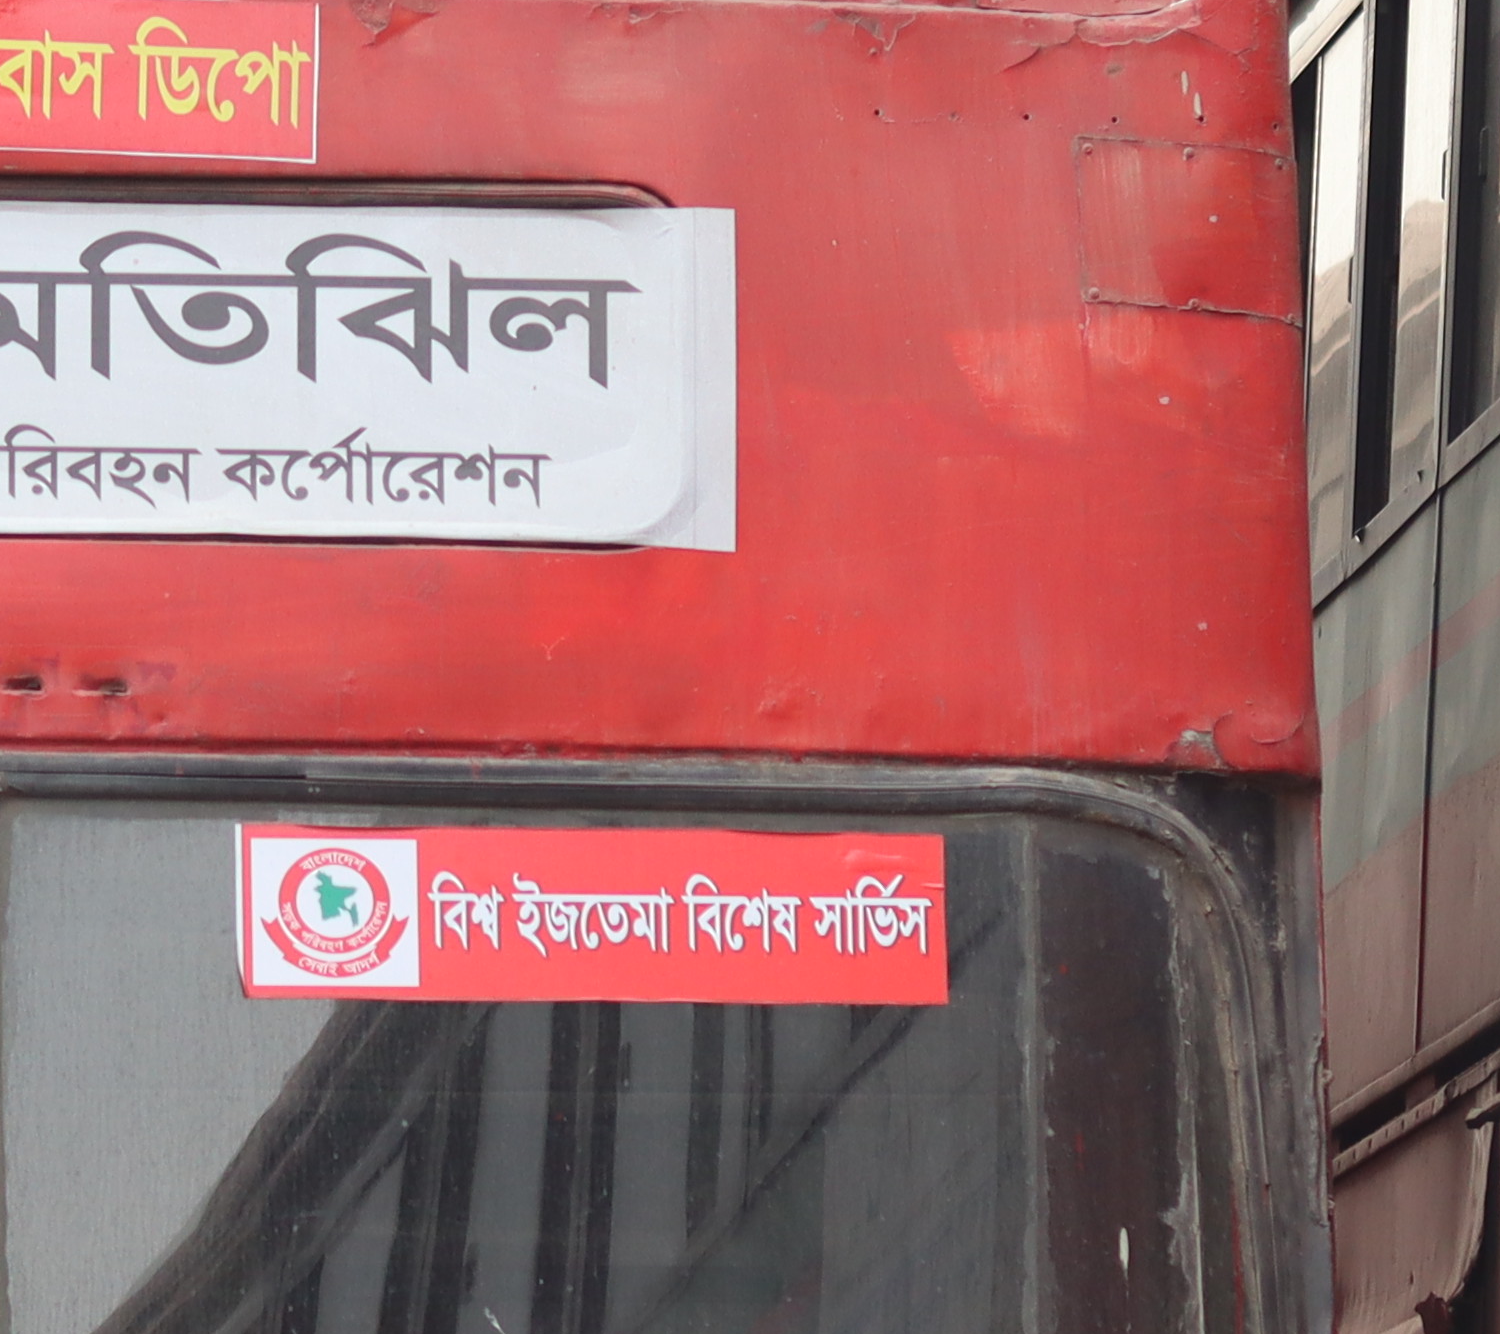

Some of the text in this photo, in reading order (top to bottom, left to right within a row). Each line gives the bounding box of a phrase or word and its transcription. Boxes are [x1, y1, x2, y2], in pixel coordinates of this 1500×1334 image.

[129, 16, 312, 130] ডিপো
[215, 427, 553, 509] কর্পোরেশন
[301, 851, 367, 872] বাংলাদেশ
[428, 870, 934, 957] বিশ্ব ইজতেমা বিশেষ সার্ভিস
